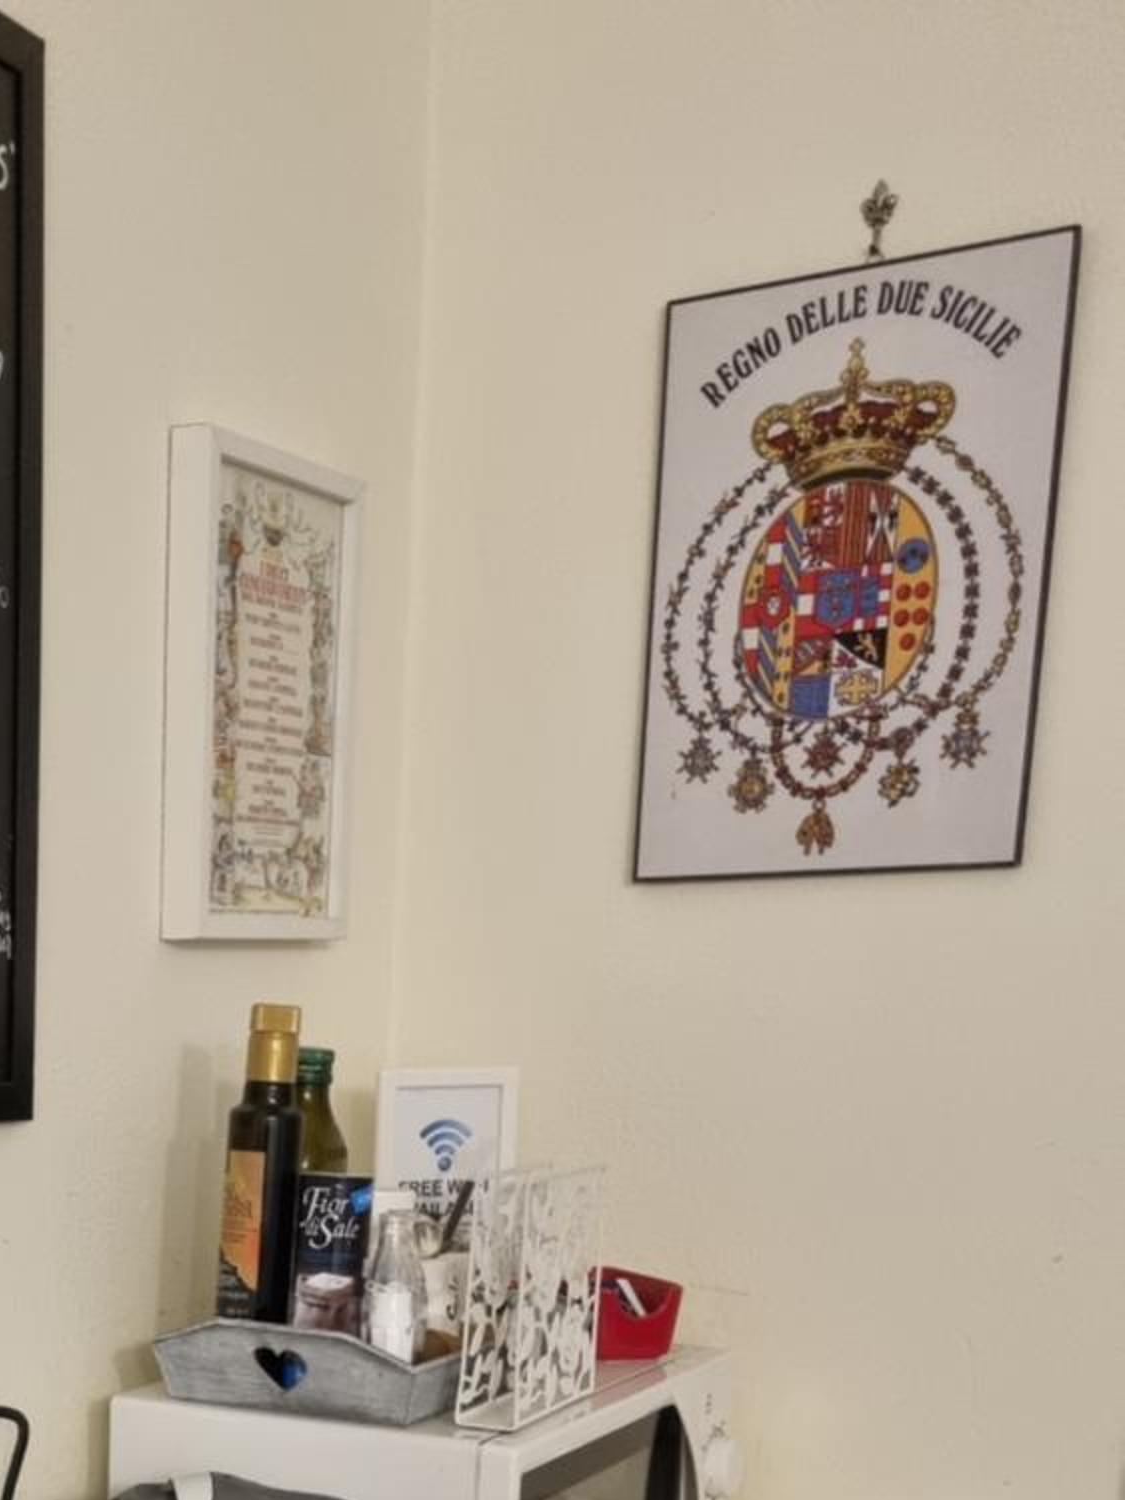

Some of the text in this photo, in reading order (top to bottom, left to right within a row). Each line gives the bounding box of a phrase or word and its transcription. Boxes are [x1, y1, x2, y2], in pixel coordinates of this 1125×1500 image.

[699, 279, 1022, 409] REGNO DELLE DUE SICILIE
[301, 1187, 350, 1224] Fior
[308, 1213, 360, 1250] Sale
